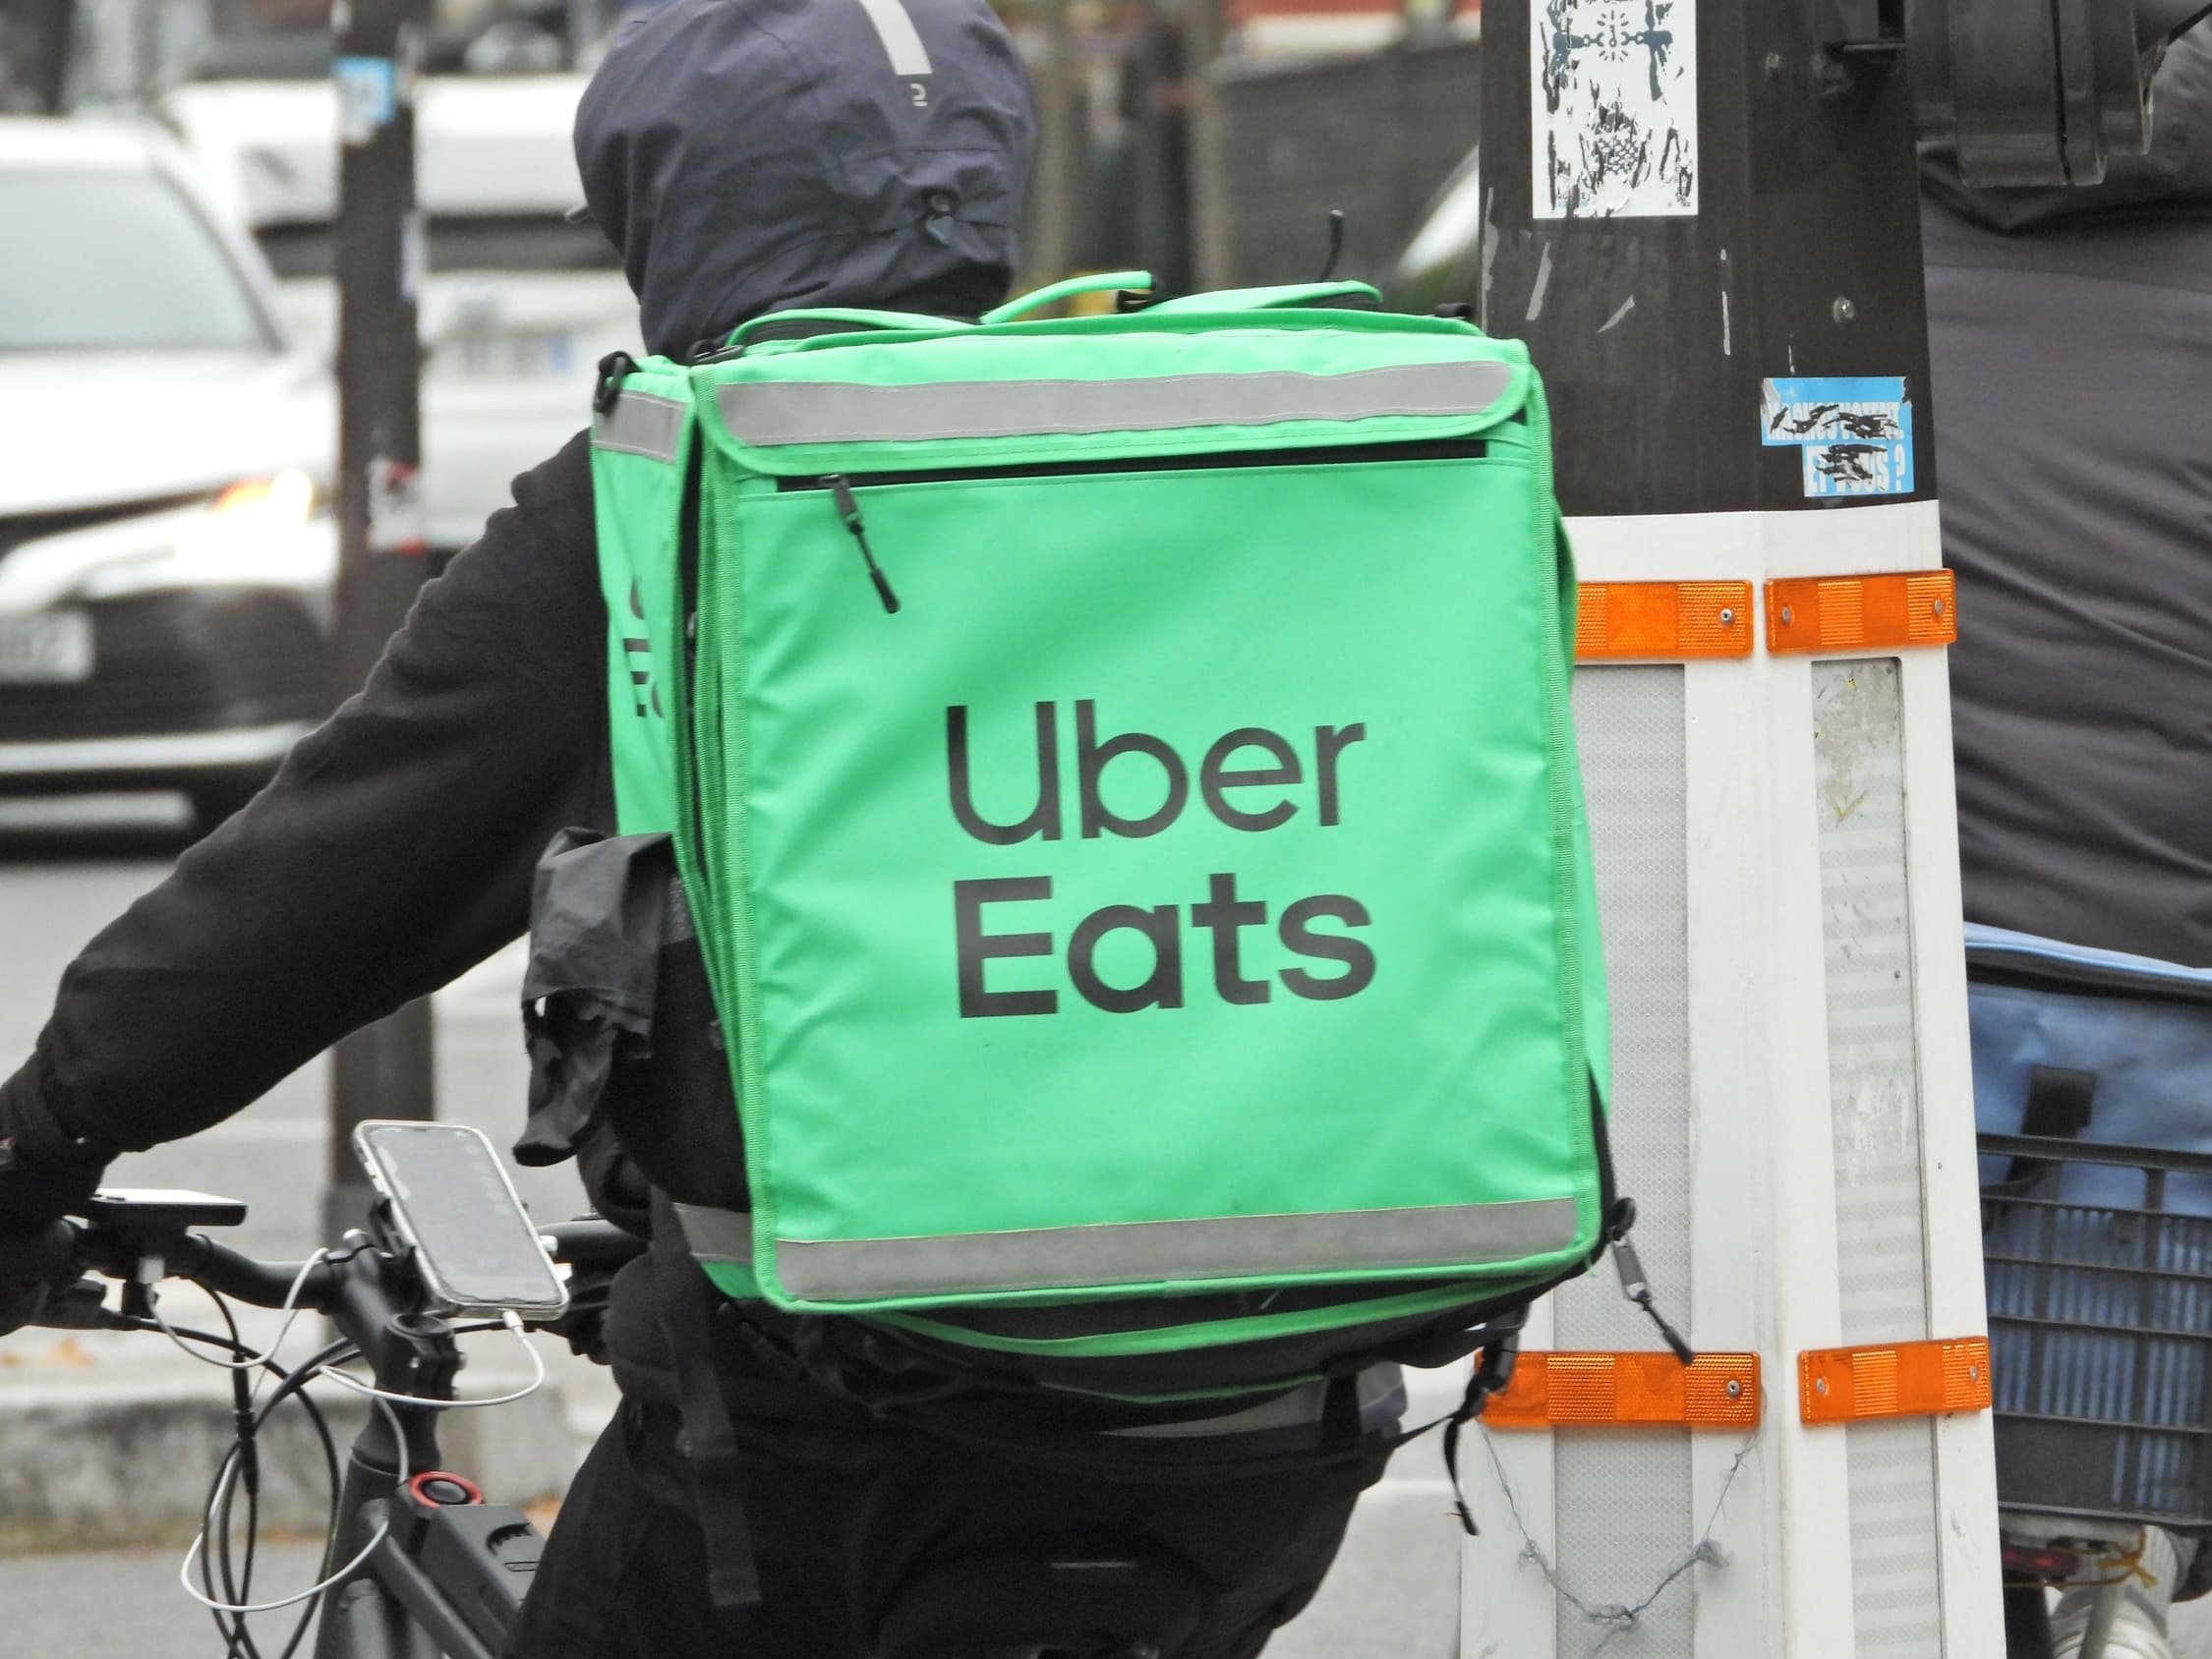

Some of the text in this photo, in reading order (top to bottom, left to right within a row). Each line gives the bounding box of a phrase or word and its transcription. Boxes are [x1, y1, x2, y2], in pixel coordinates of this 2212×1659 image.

[1893, 443, 1906, 492] ?
[946, 699, 1367, 845] Uber
[954, 873, 1376, 1018] Eats
